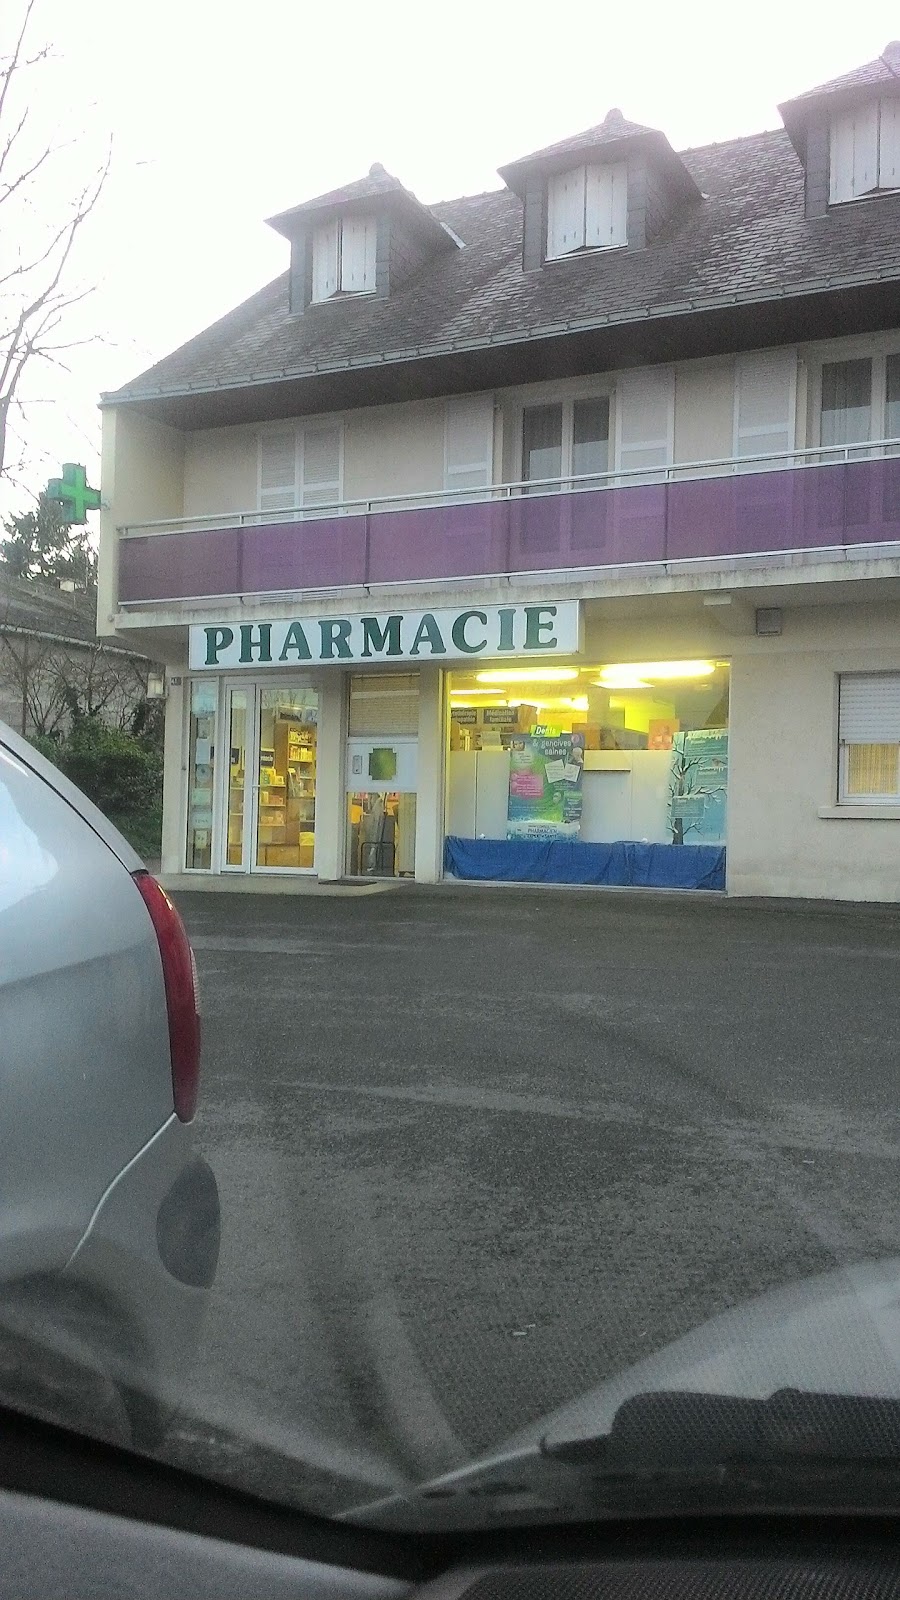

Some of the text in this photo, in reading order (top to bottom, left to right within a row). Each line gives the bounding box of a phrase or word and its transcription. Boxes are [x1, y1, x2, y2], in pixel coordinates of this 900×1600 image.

[204, 605, 558, 666] PHARMACIE
[536, 726, 556, 735] Dents
[540, 740, 572, 749] gencives
[544, 748, 567, 756] saines
